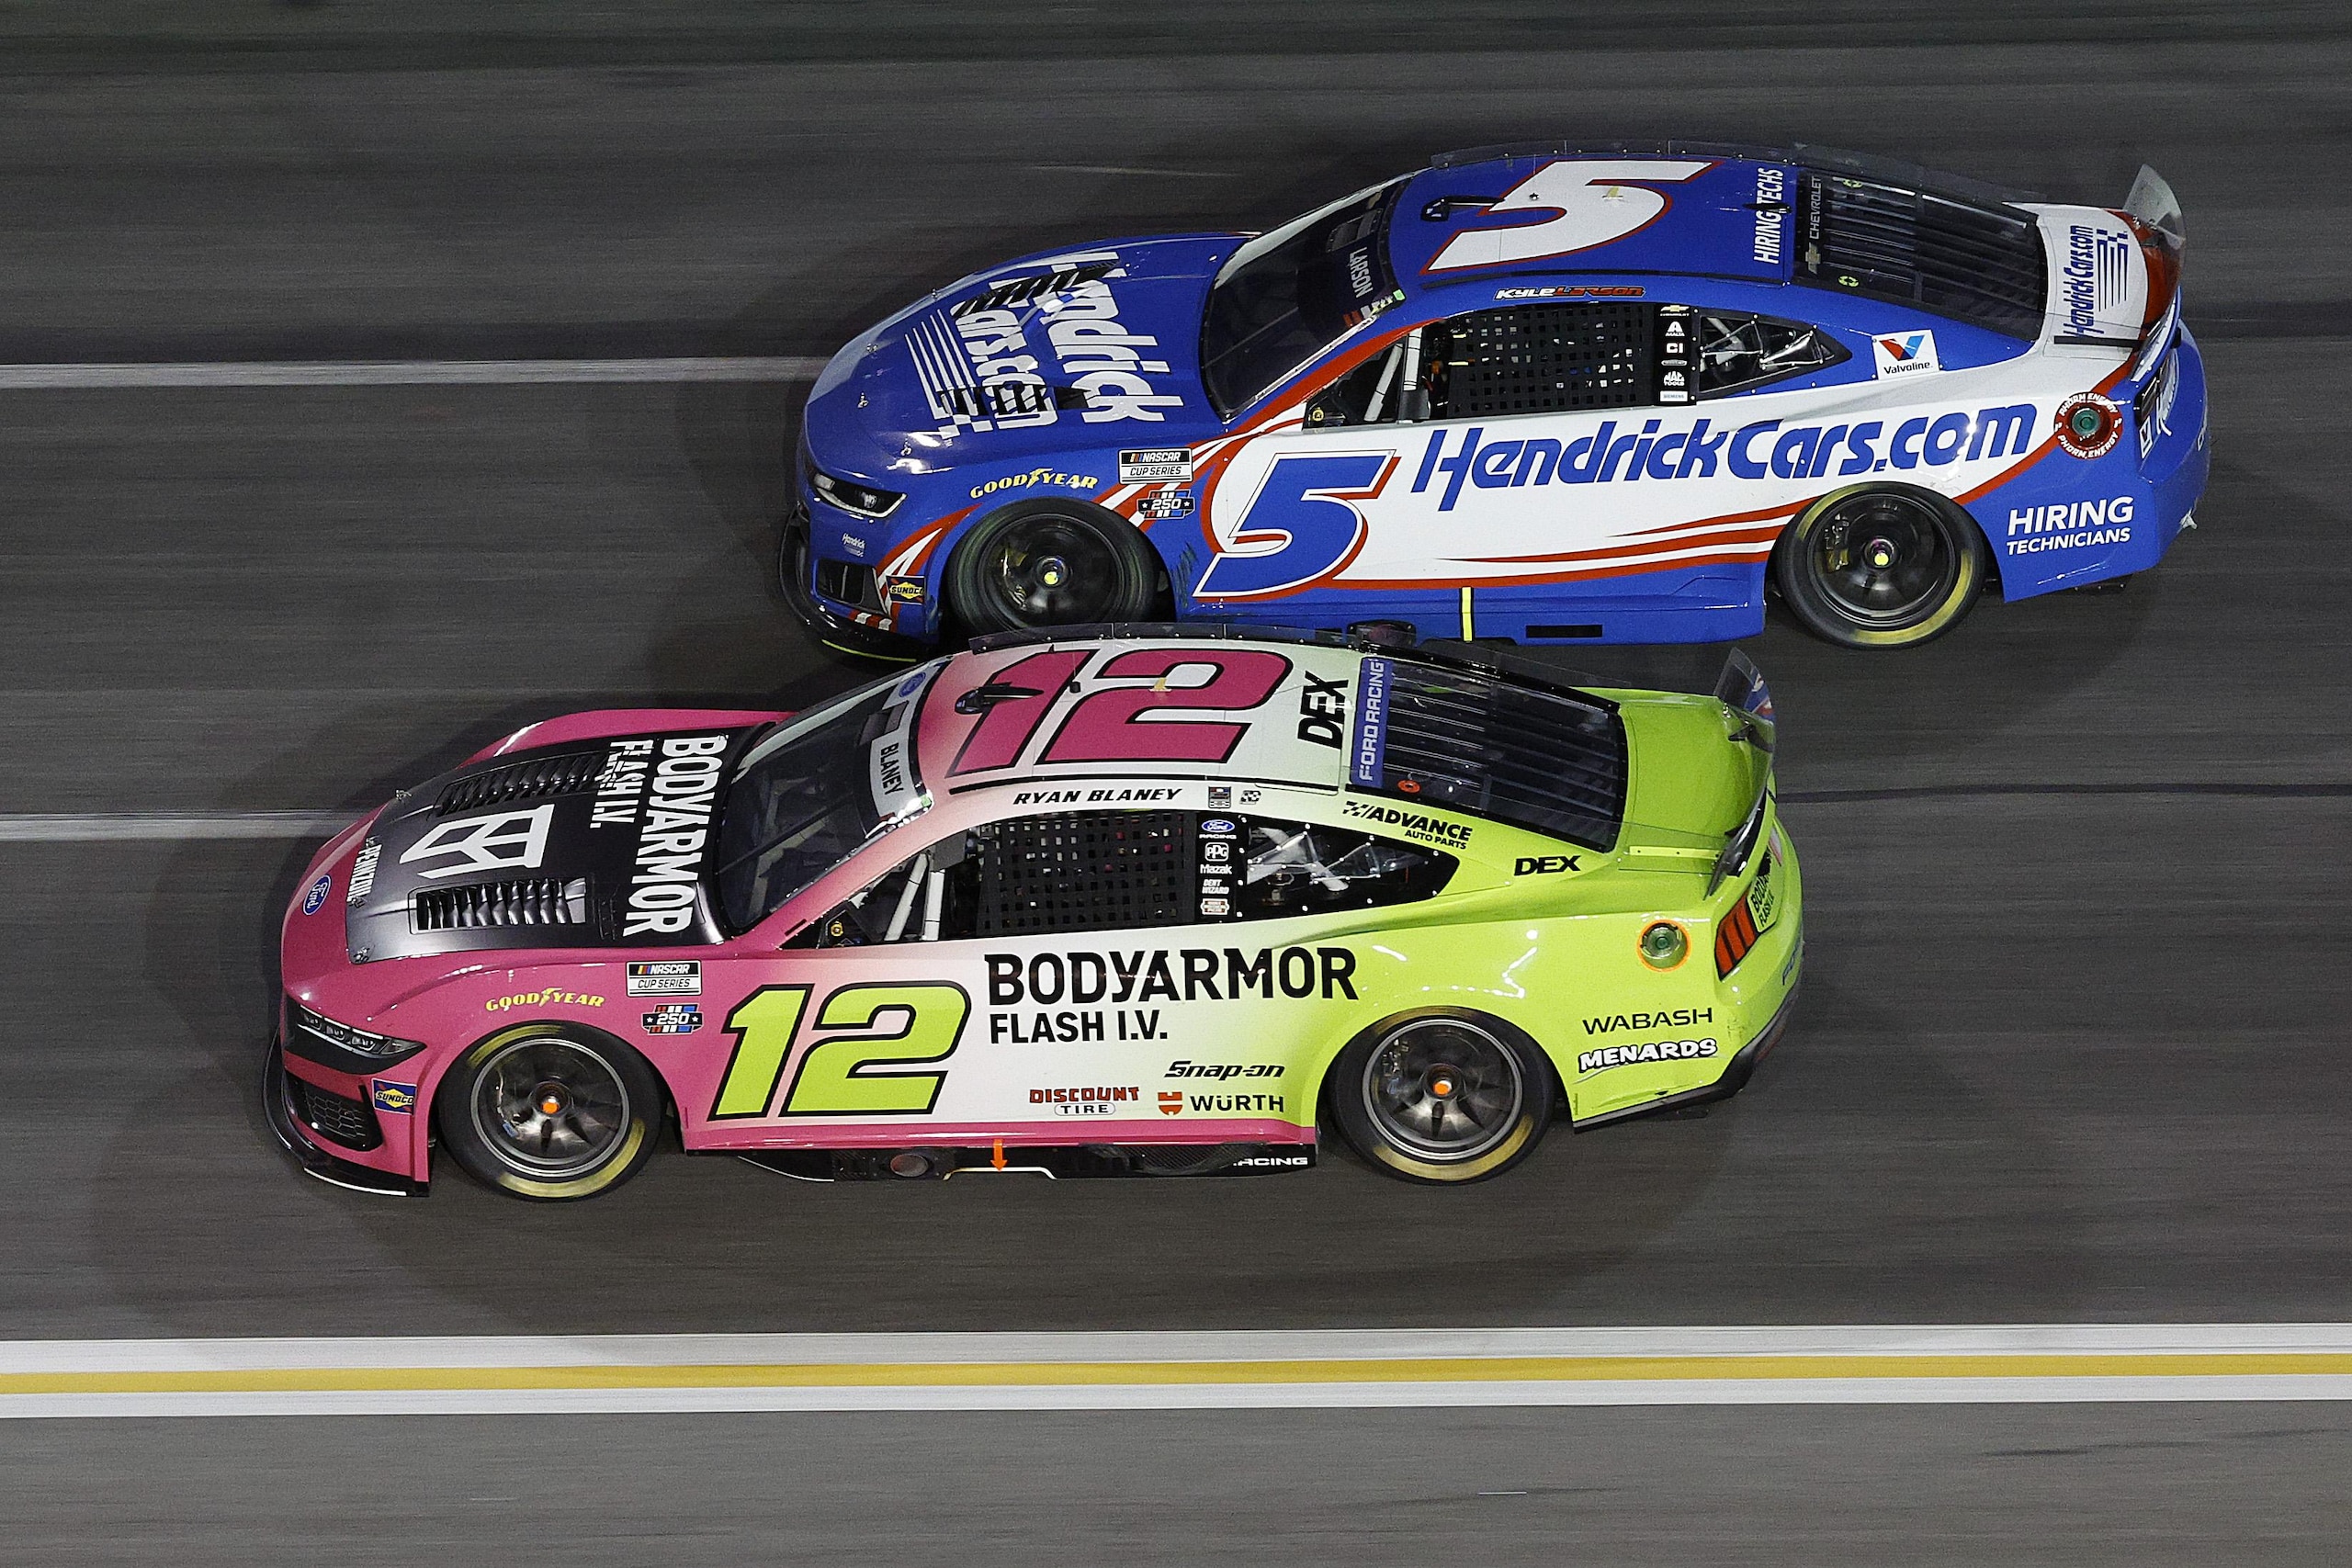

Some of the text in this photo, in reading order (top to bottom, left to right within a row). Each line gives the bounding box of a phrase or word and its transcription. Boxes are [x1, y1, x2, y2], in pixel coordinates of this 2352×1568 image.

[1420, 159, 1722, 274] 5
[1753, 167, 1784, 265] HIRING TECHS
[1808, 175, 1822, 240] CHEVROLET
[1348, 246, 1374, 299] LARSON
[1883, 362, 1930, 374] Valvoline
[1129, 466, 1182, 477] CUP SERIES
[1142, 452, 1182, 463] NASCAR
[1411, 403, 2038, 511] HendrickCars.com
[1150, 498, 1182, 510] 250
[2007, 496, 2134, 536] HIRING
[1193, 449, 1399, 601] 5
[2006, 527, 2132, 556] TECHNICIANS
[945, 648, 1294, 778] 12
[1297, 670, 1349, 750] DEX
[1359, 660, 1385, 781] FORD RACING
[880, 742, 904, 795] BLANEY
[1012, 788, 1182, 805] RYAN BLANEY
[590, 799, 639, 829] I.V.
[1367, 807, 1474, 841] ADVANCE
[623, 735, 729, 937] BODYARMOR
[1404, 829, 1467, 850] AUTO PARTS
[1206, 845, 1227, 860] PPG
[1514, 855, 1582, 876] DEX
[346, 844, 382, 902] PENNZOIL
[1200, 864, 1233, 874] Mazak
[305, 880, 329, 910] Ford
[638, 978, 691, 988] CUP SERIES
[650, 964, 690, 975] NASCAR
[984, 947, 1359, 1005] BODYARMOR
[485, 987, 605, 1011] GOODYEAR
[656, 1012, 690, 1025] 250
[990, 1010, 1169, 1044] FLASH I.V.
[1582, 1007, 1713, 1035] WABASH
[708, 980, 971, 1121] 12
[1578, 1038, 1718, 1073] MENARDS
[1164, 1060, 1285, 1081] Snap-on
[377, 1092, 414, 1104] SUNOCO
[1029, 1087, 1139, 1103] DISCOUNT
[1060, 1104, 1109, 1115] TIRE
[1233, 1156, 1308, 1167] ACING
